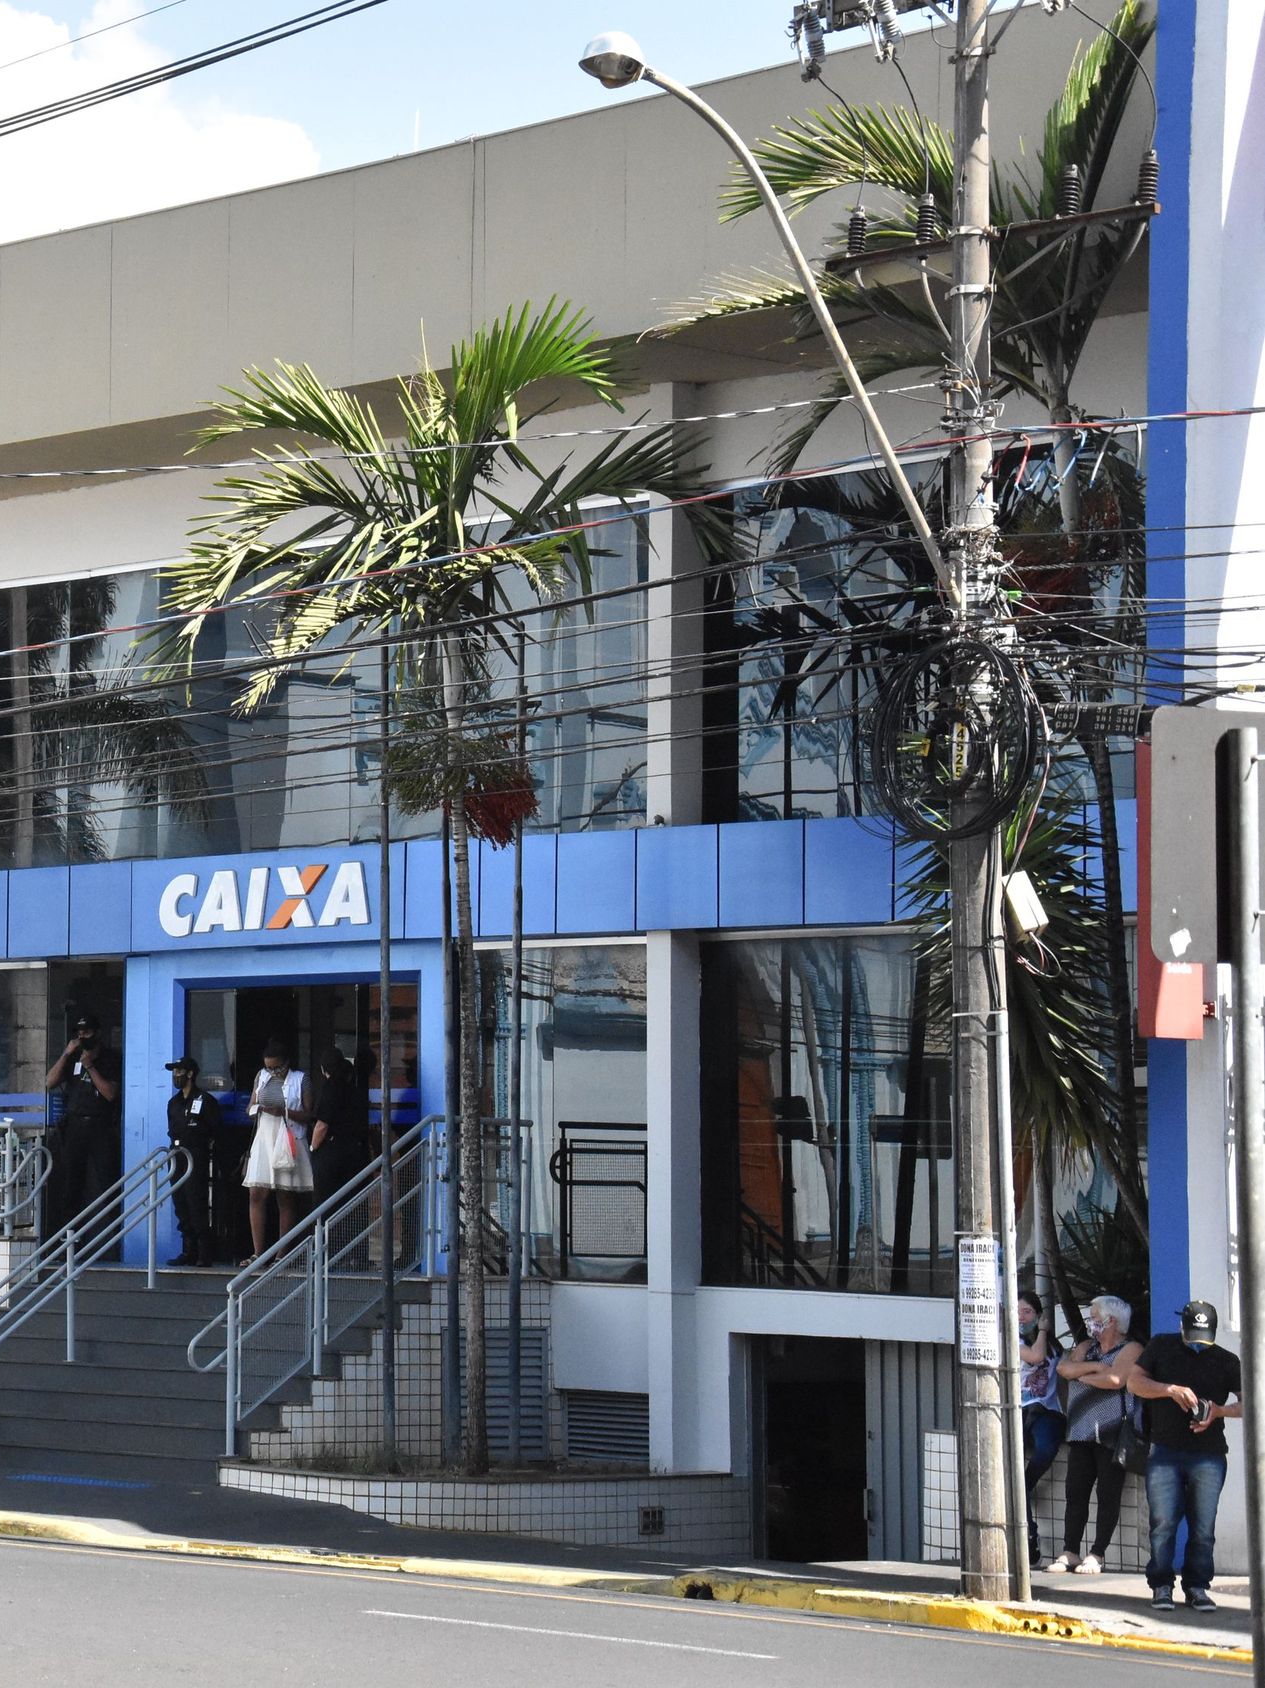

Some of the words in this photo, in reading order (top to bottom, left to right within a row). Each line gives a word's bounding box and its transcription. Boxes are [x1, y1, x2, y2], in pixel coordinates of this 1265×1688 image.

[955, 722, 966, 778] 4525
[159, 861, 371, 938] CAIXA
[961, 1244, 974, 1253] DONA
[976, 1243, 995, 1254] IRACI
[962, 1304, 975, 1314] DONA
[977, 1304, 996, 1315] IRACI
